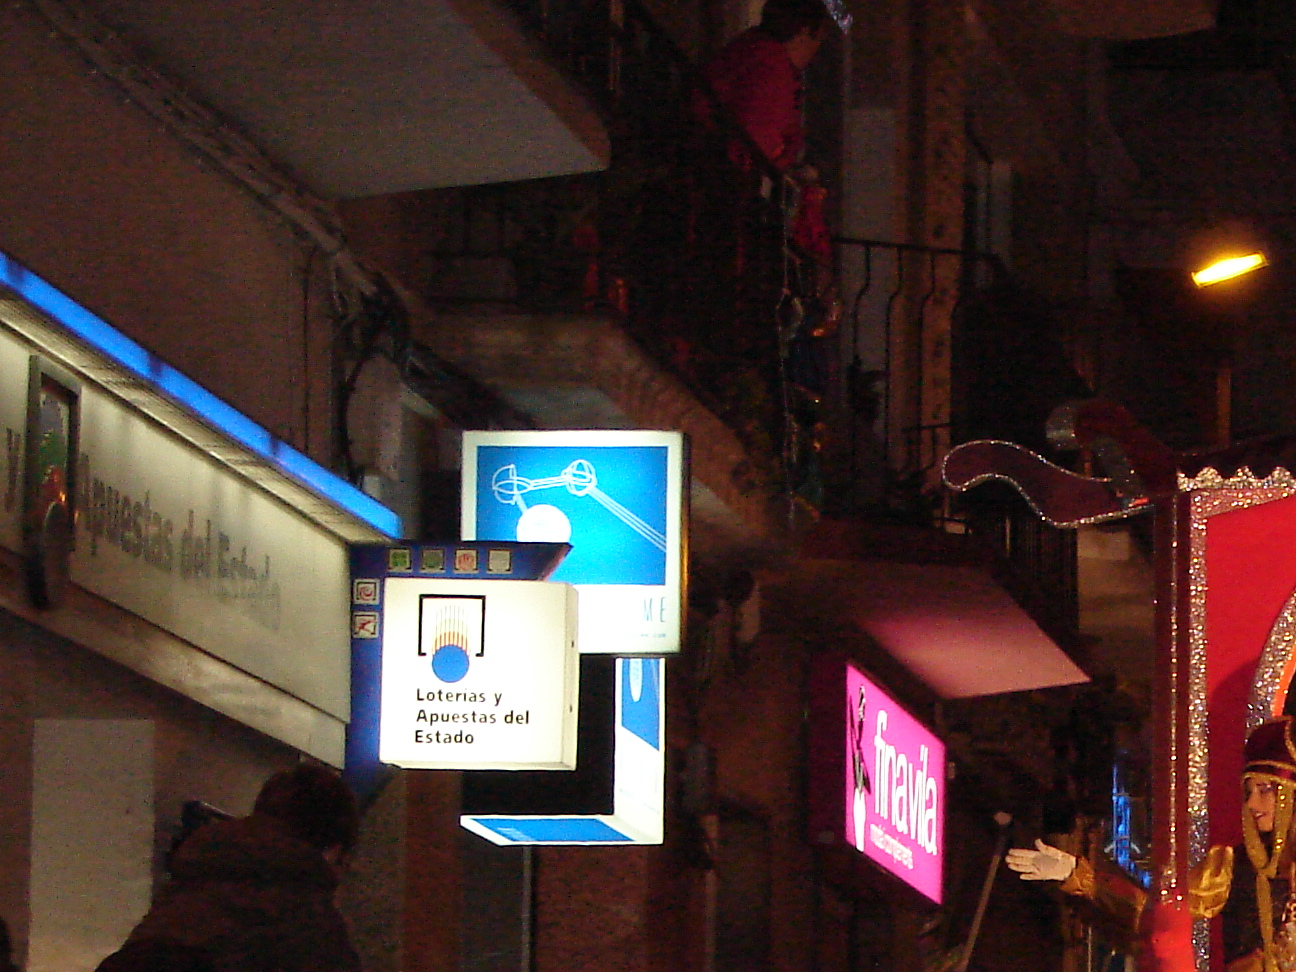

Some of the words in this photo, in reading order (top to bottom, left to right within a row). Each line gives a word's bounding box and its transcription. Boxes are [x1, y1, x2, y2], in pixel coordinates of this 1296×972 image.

[494, 692, 503, 707] y
[416, 708, 497, 727] Apuestas
[504, 709, 530, 725] del
[414, 729, 475, 745] Estado
